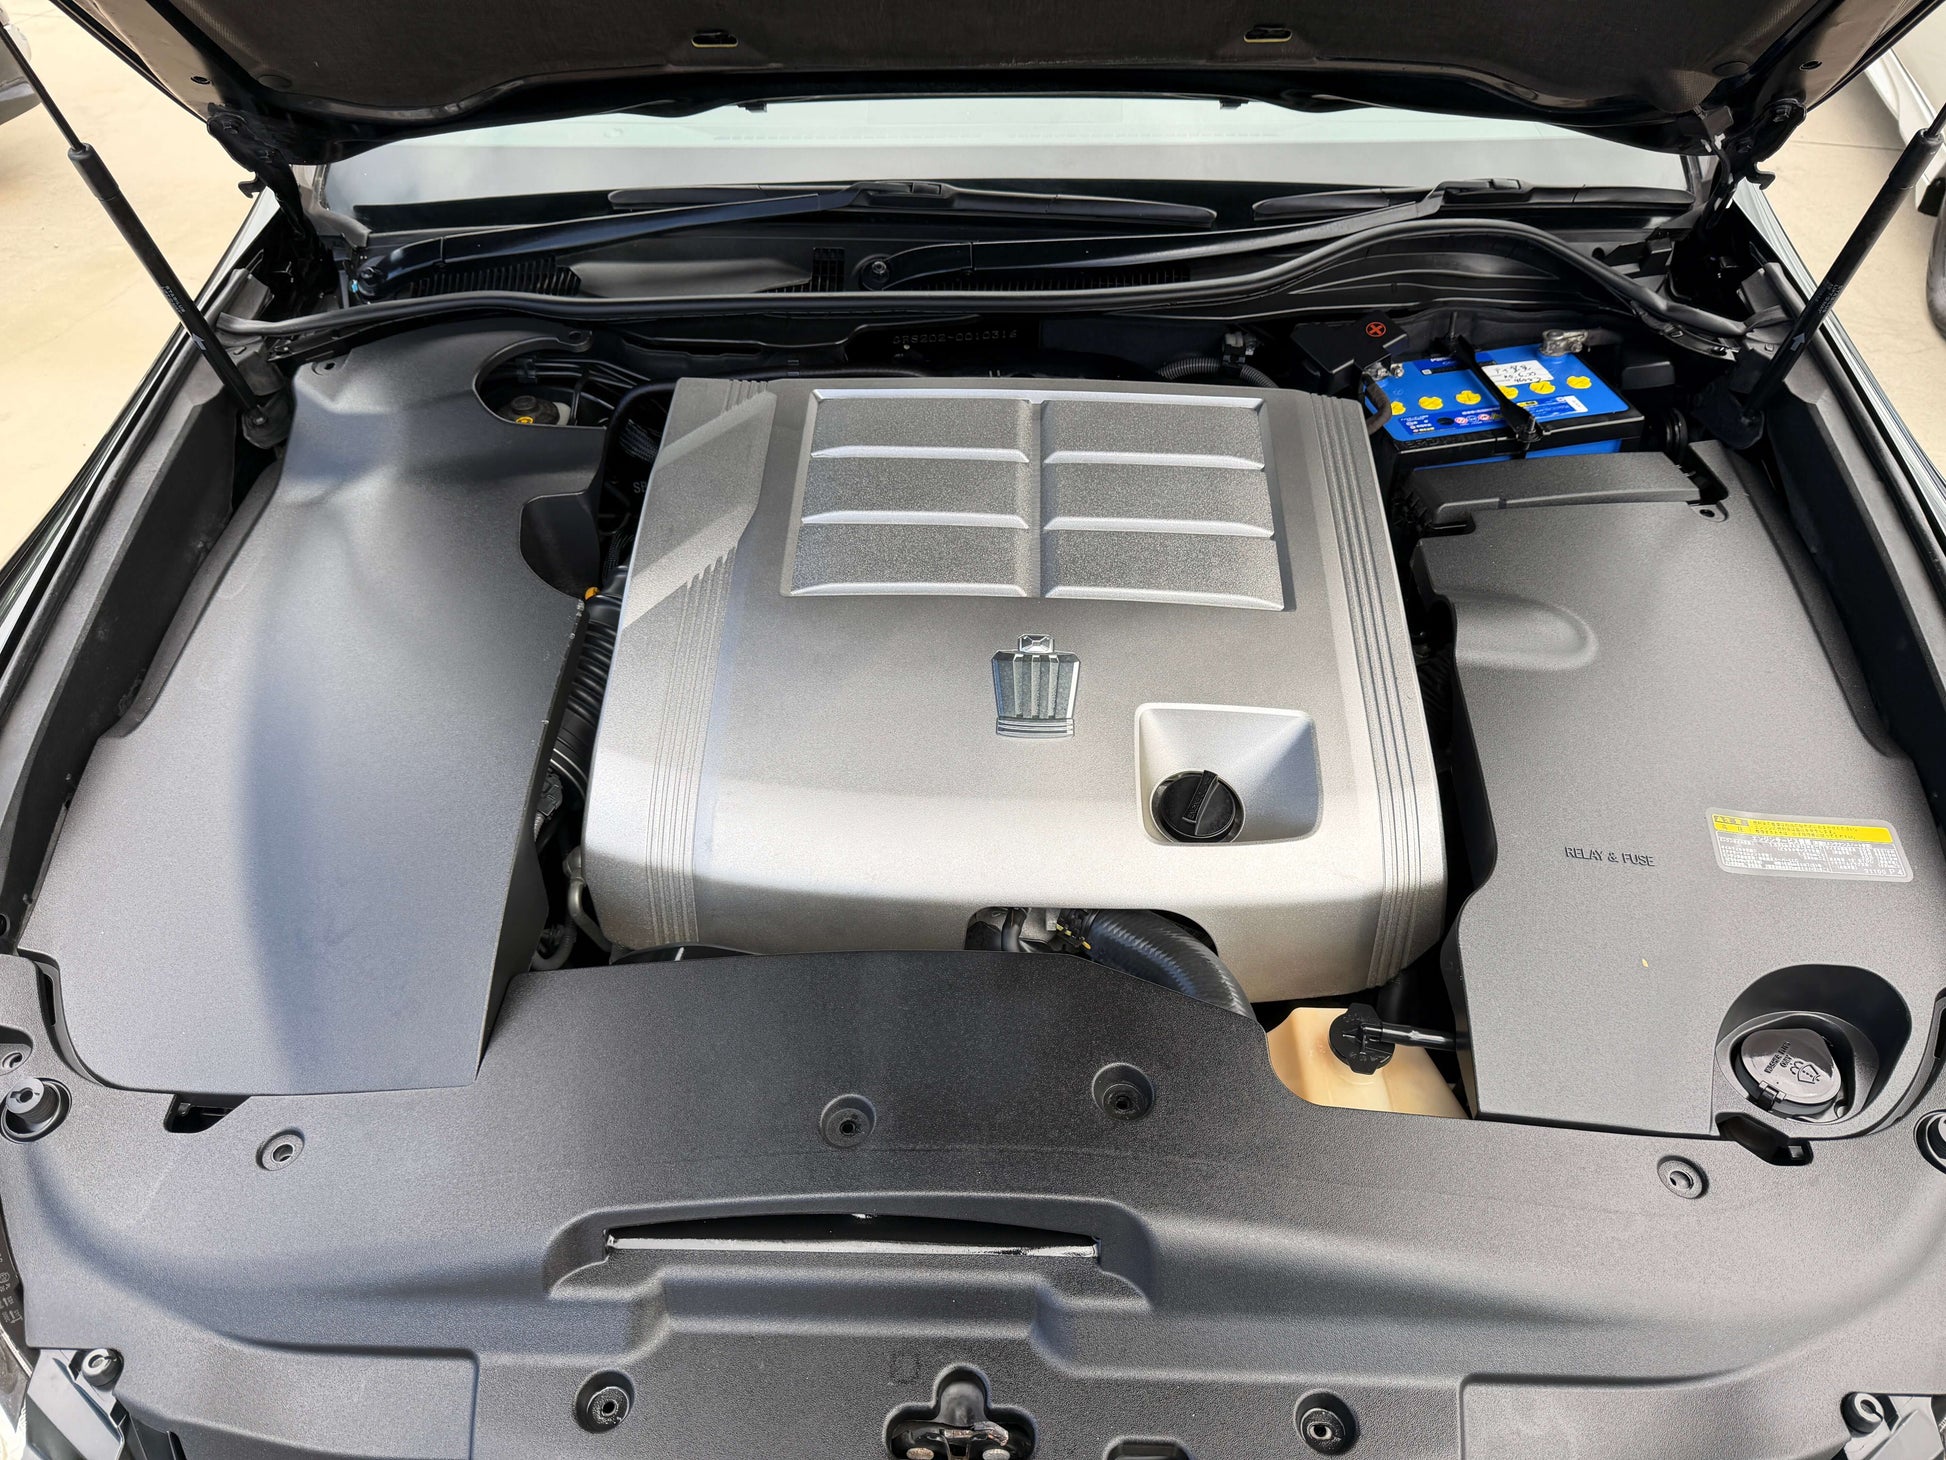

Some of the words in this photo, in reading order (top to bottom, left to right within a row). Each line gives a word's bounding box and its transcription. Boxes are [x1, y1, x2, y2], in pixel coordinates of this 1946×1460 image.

[1564, 846, 1603, 861] RELAY
[1607, 852, 1618, 863] &
[1621, 852, 1655, 866] FUSE
